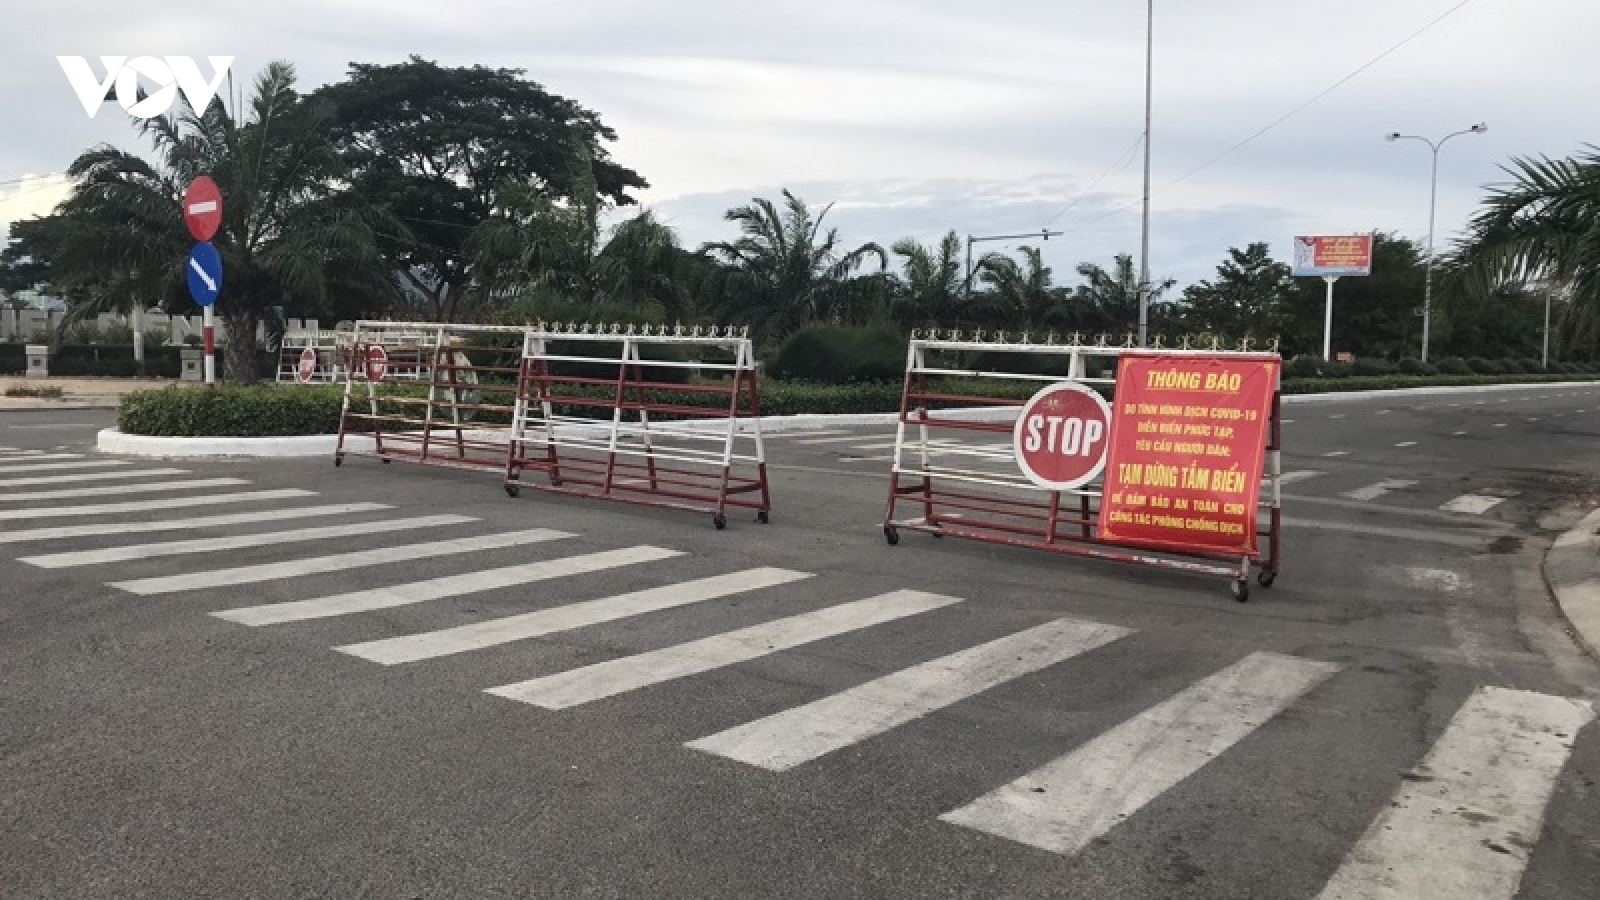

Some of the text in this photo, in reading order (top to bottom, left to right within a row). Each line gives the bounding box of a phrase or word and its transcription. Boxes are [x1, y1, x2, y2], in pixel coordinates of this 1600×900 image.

[1147, 367, 1242, 391] THÔNG BÁO
[1210, 407, 1257, 421] COVID-19
[1025, 413, 1103, 457] STOP
[1119, 463, 1142, 488] TẠM
[1144, 460, 1179, 488] DỪNG
